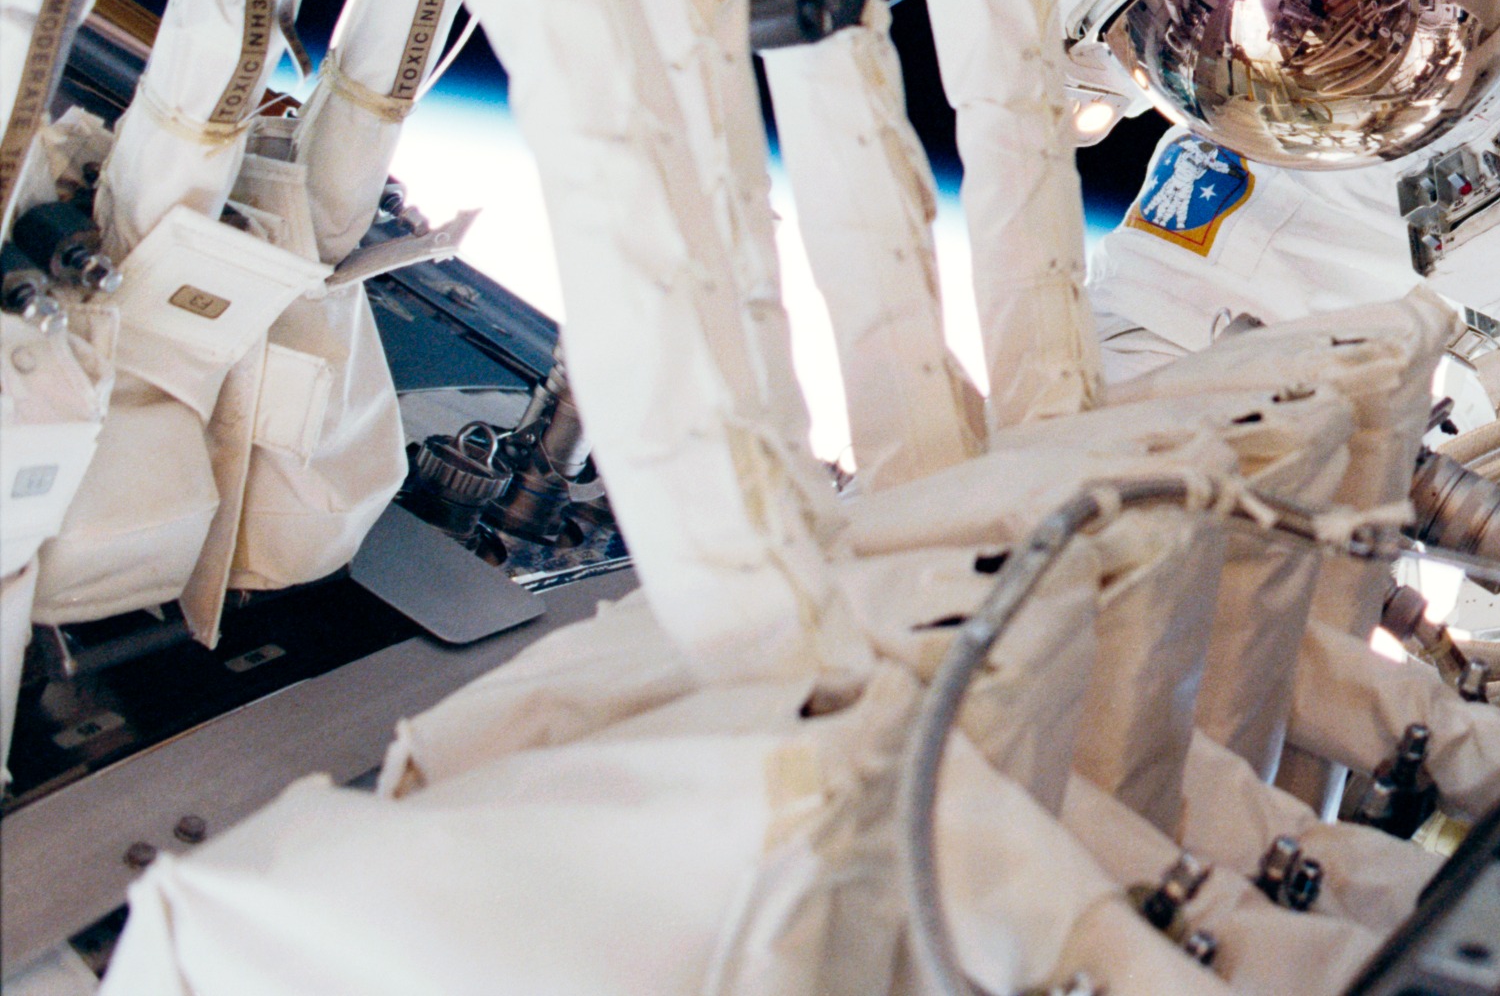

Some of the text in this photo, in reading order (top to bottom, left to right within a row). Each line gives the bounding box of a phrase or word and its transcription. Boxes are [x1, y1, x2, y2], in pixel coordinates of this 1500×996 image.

[219, 0, 267, 117] TOXIC NH3
[399, 32, 429, 94] TOXIC
